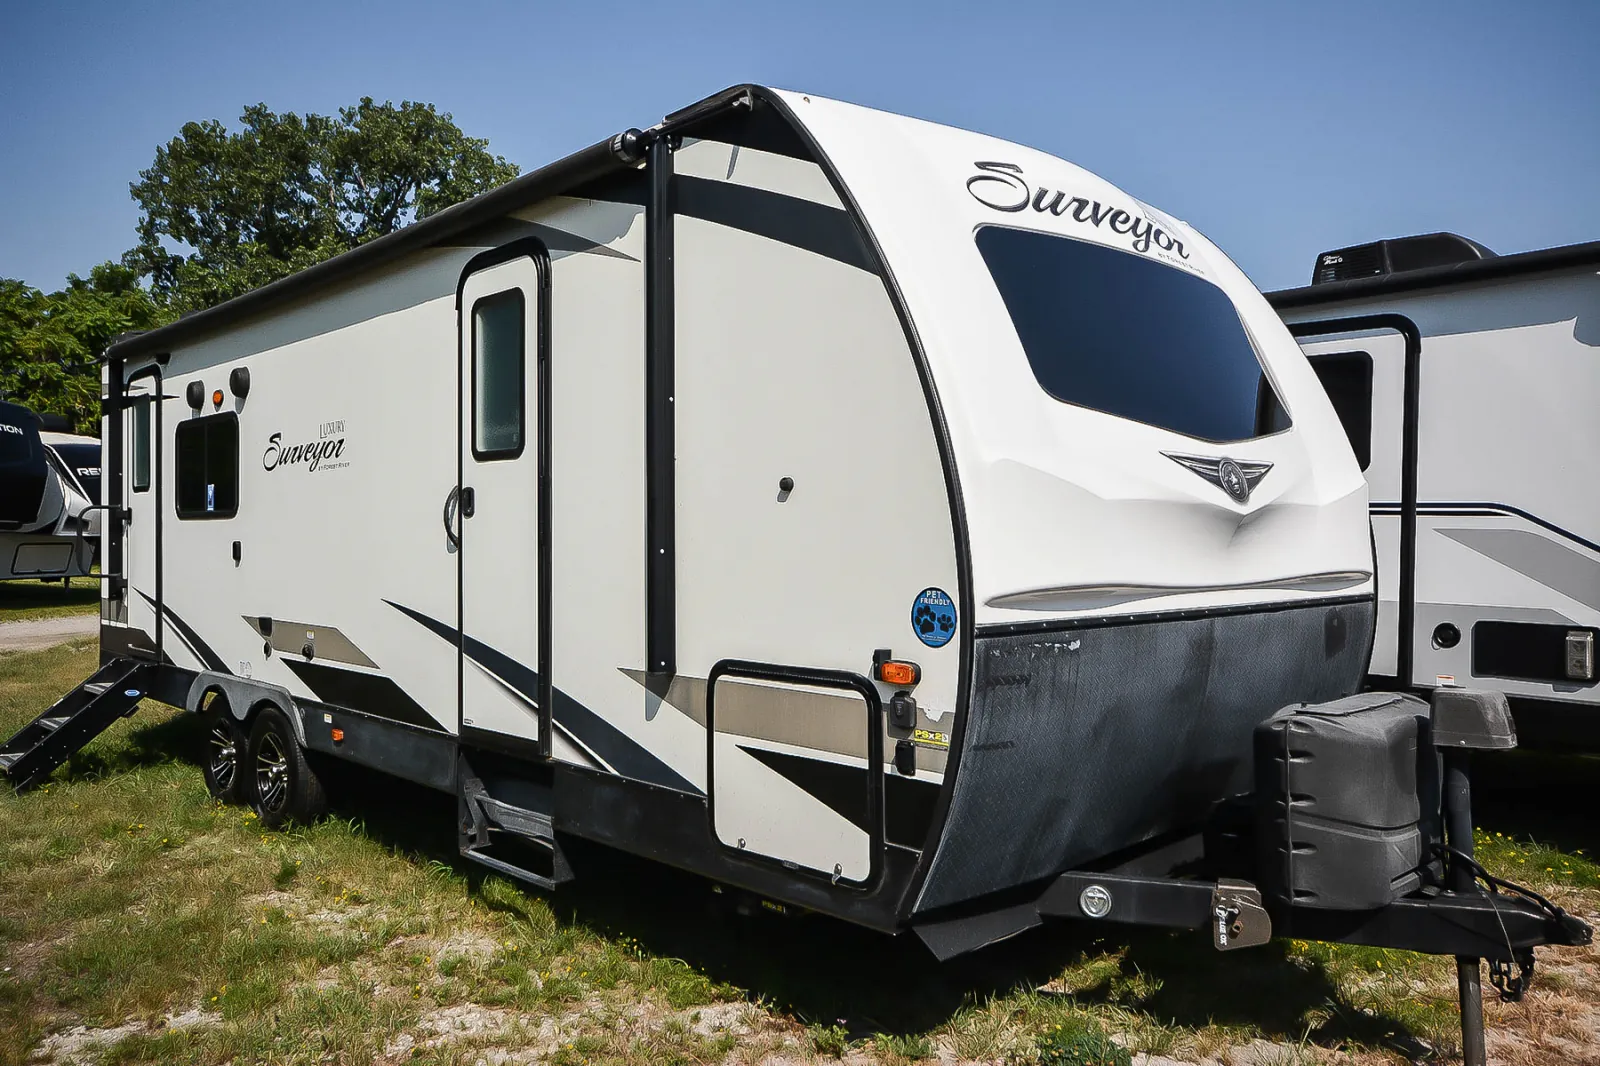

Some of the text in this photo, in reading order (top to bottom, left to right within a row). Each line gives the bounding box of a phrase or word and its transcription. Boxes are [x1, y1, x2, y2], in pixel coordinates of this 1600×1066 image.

[966, 161, 1189, 259] Surveyor
[319, 420, 346, 439] LUXURY
[263, 432, 346, 472] Surveyor
[920, 597, 951, 606] FRIENDLY
[926, 590, 942, 599] PET
[915, 729, 942, 741] PSx2
